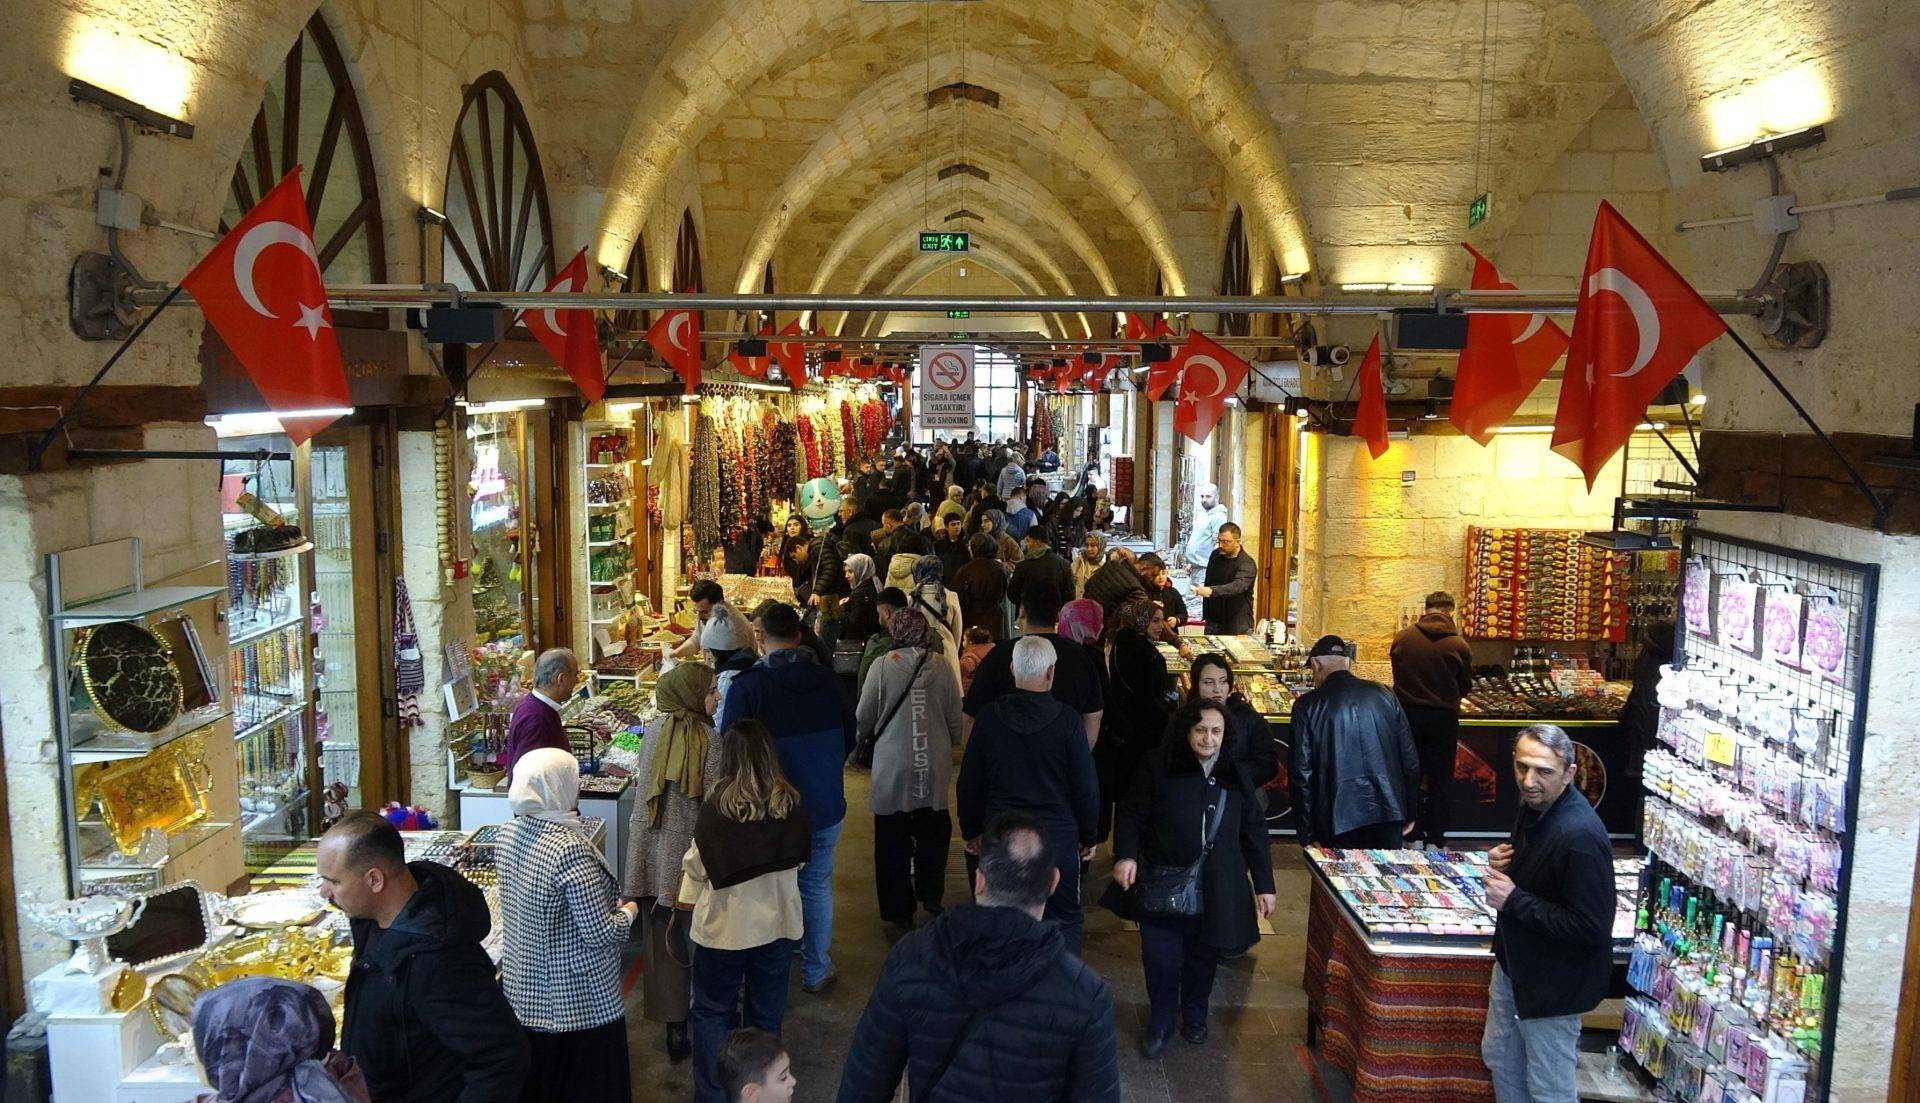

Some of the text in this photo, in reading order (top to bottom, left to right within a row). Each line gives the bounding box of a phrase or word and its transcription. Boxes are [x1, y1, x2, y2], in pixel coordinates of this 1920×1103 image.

[923, 392, 971, 402] SİGARA İÇMEK
[926, 416, 968, 424] NO SMOKING
